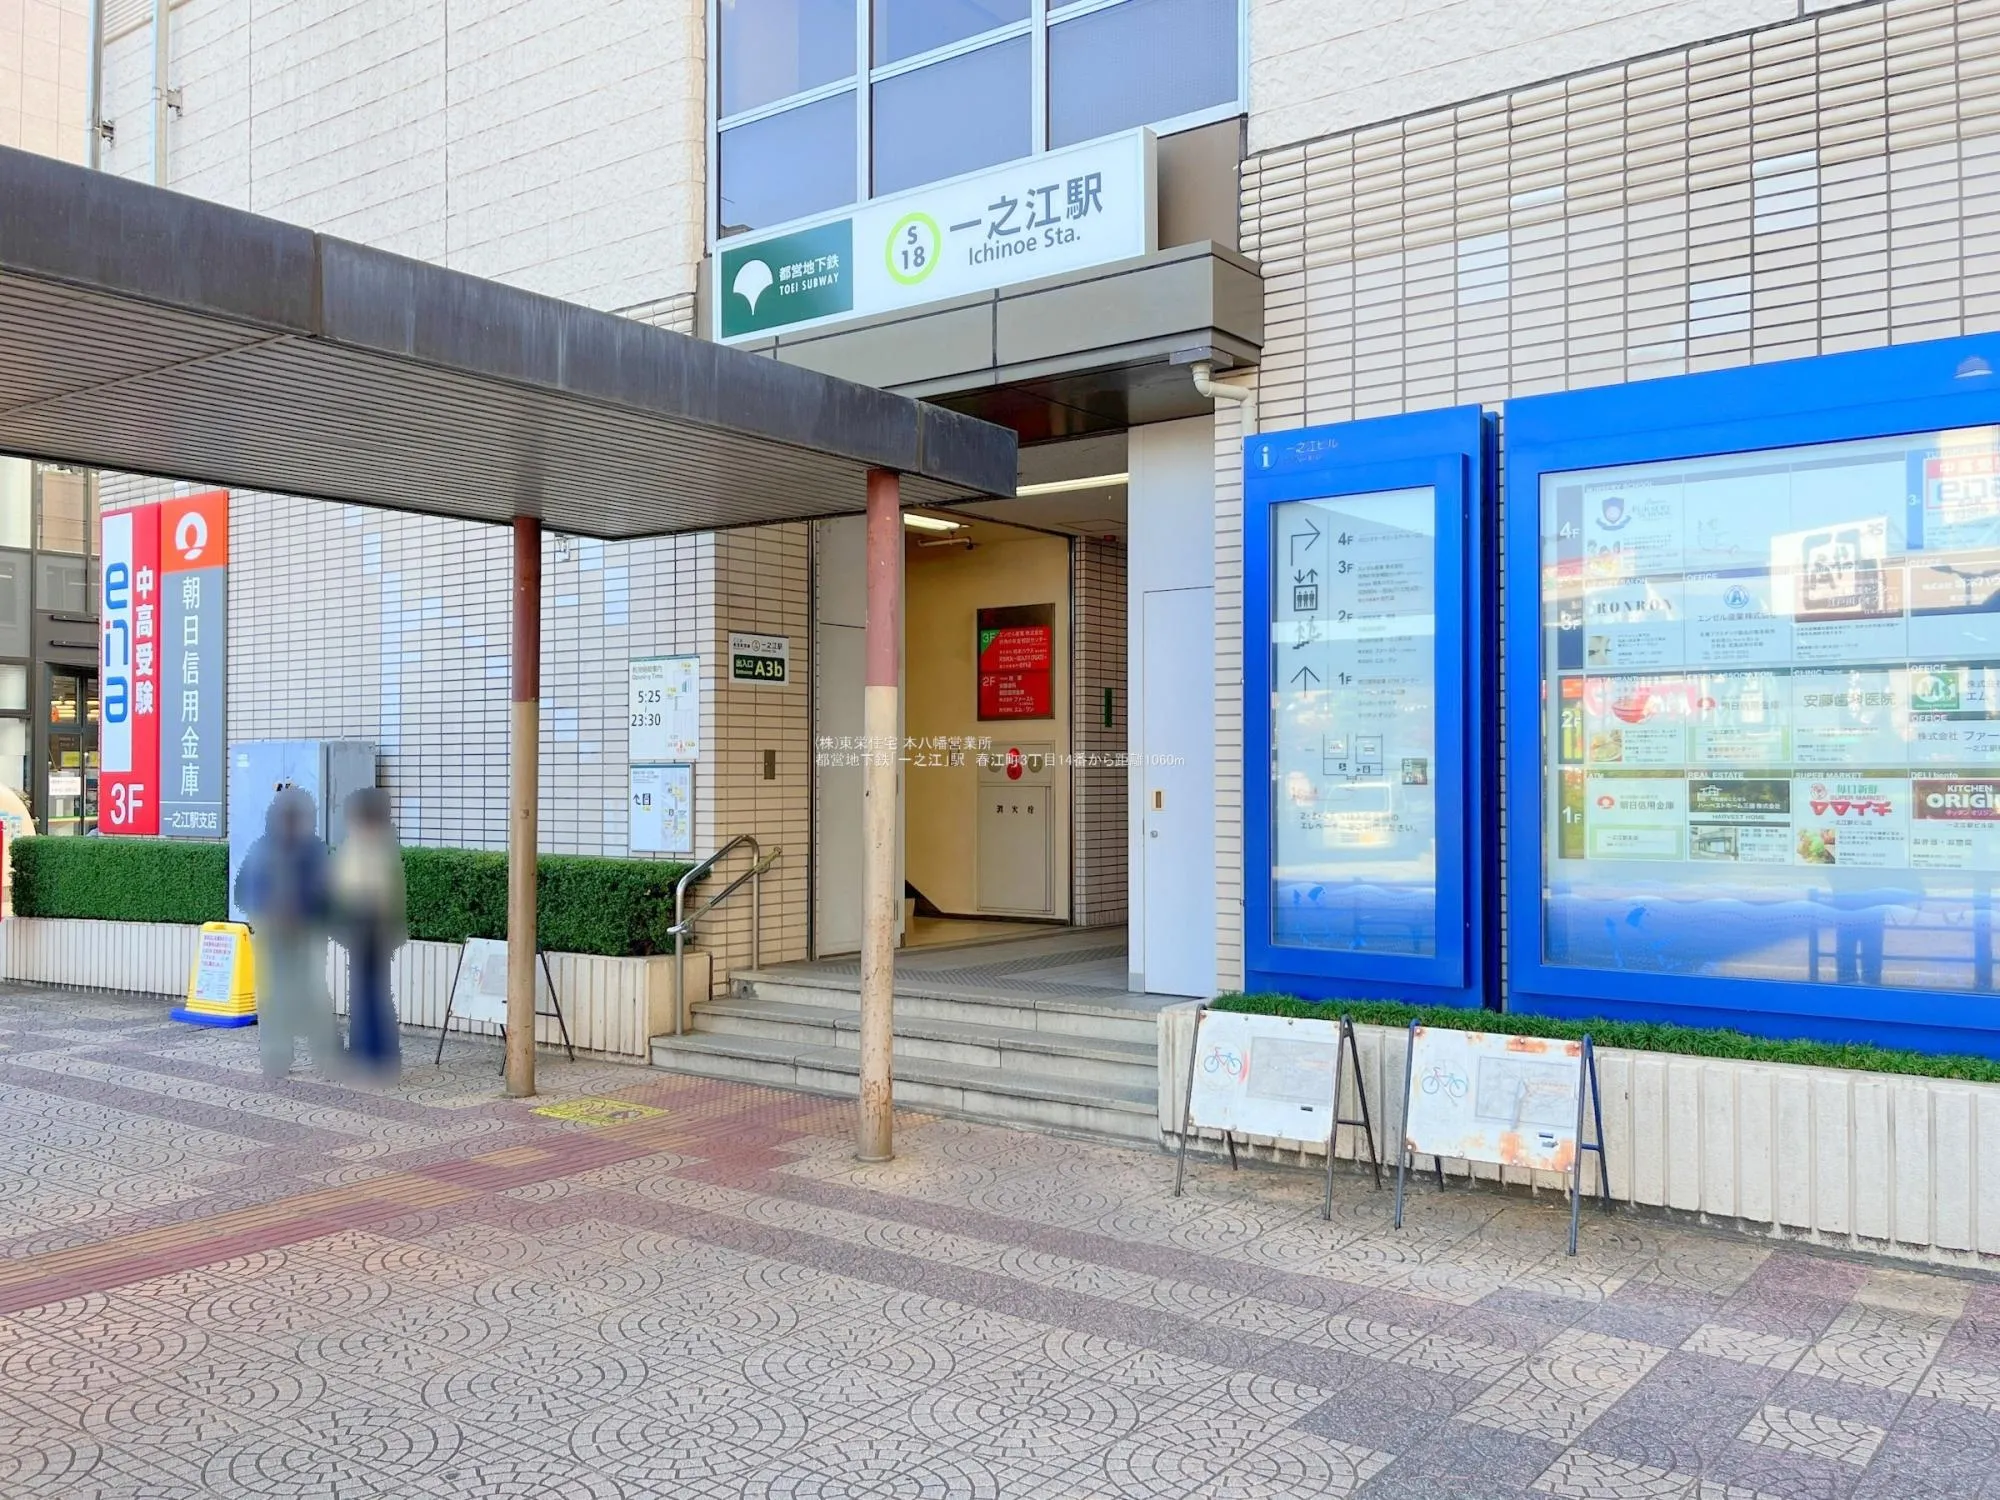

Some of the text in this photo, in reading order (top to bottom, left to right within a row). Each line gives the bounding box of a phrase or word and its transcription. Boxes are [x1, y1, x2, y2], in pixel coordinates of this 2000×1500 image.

[949, 171, 1103, 240] 一之江駅
[907, 225, 918, 246] S
[968, 228, 1081, 267] Ichinoe Sta.
[901, 246, 926, 270] 18
[779, 254, 839, 281] 都営地下鉄
[779, 272, 839, 296] TOEI SUBWAY
[1559, 521, 1580, 539] 4F
[1337, 532, 1353, 546] 4F
[1337, 560, 1353, 574] 3F
[1337, 610, 1353, 621] 2F
[135, 565, 154, 715] 中高受験
[982, 632, 996, 643] 3F
[754, 660, 783, 677] A3b
[181, 576, 200, 797] 朝日信用金庫
[982, 676, 995, 687] 2F
[1338, 672, 1352, 685] 1F
[638, 689, 661, 704] 5:25
[631, 712, 661, 727] 23:30
[1561, 711, 1582, 729] 2F
[1917, 731, 1958, 741] 株式会社
[1688, 771, 1744, 779] REAL ESTATE
[1910, 771, 1932, 779] DELI
[1947, 784, 1993, 793] KITCHEN
[110, 782, 144, 826] 3F
[1926, 793, 2000, 809] ORIGI
[996, 804, 1034, 815] 消火栓
[1562, 807, 1582, 824] 1F
[164, 811, 217, 829] 一之江駅支店
